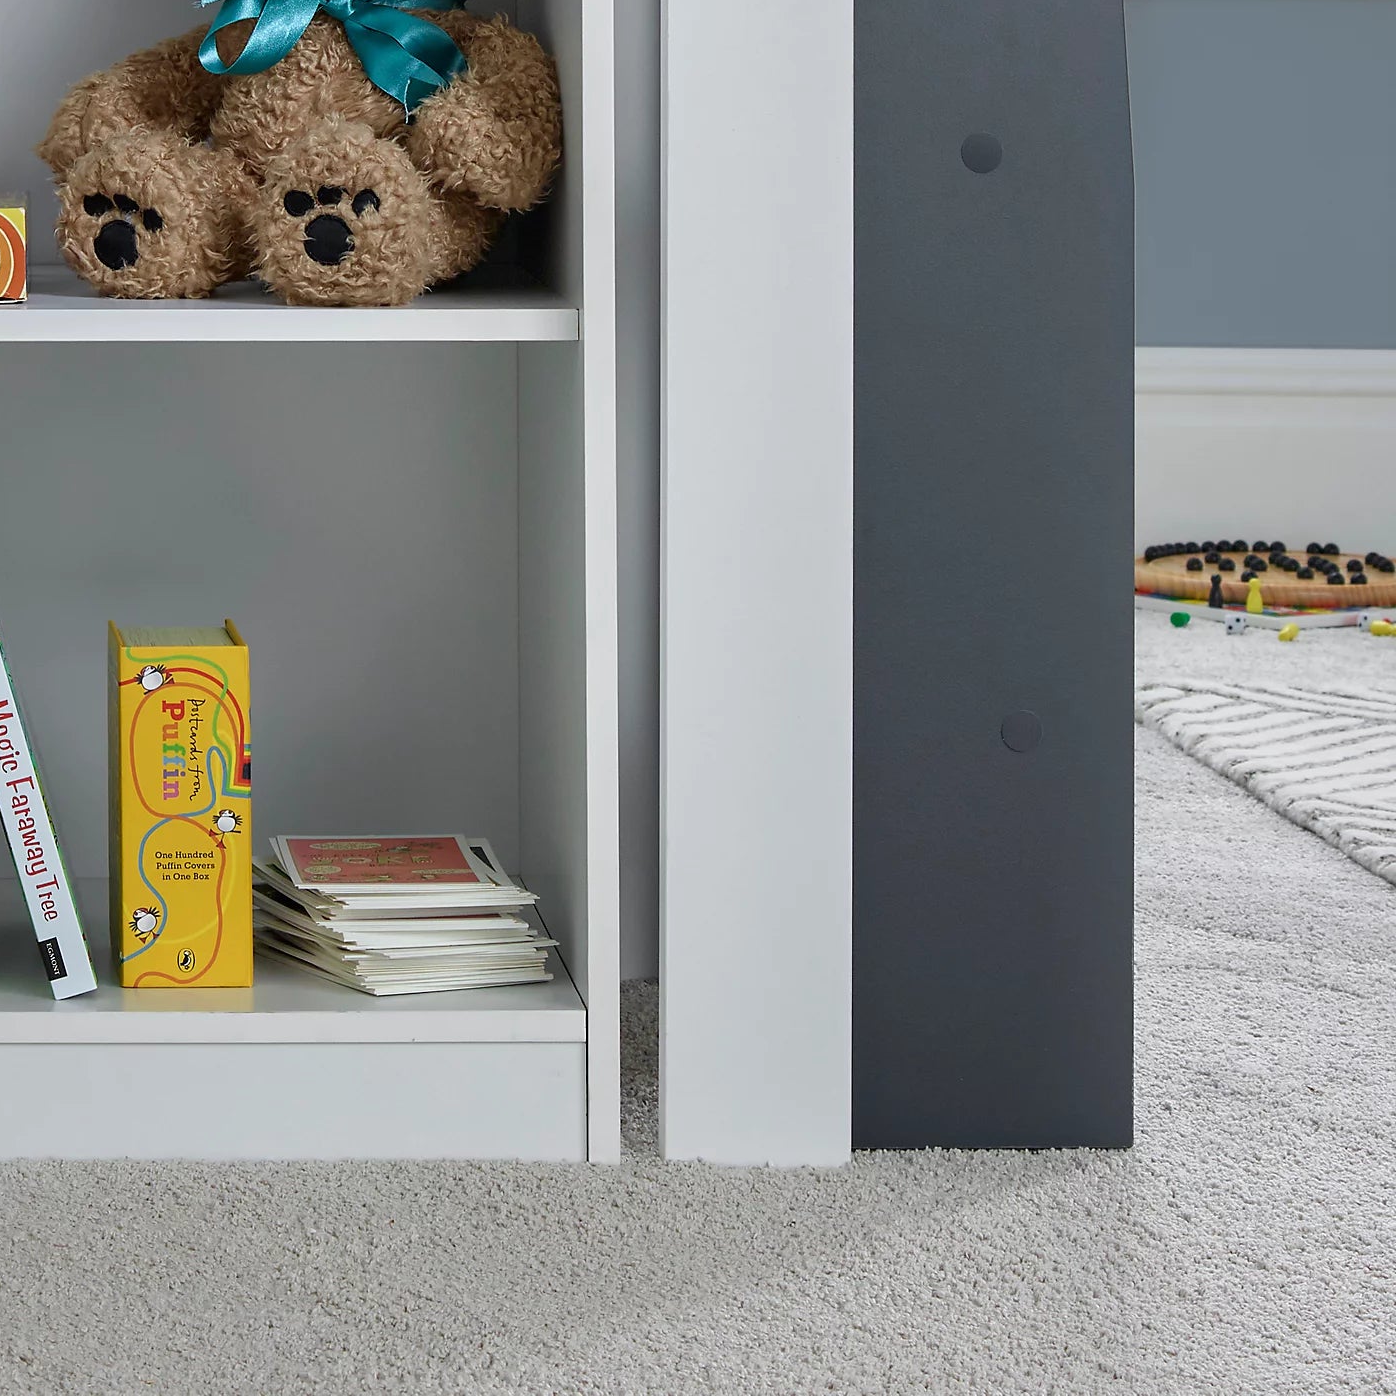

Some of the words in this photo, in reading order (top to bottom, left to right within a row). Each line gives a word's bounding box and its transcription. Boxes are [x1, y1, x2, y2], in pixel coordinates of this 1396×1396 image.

[161, 700, 186, 801] Puffin
[187, 764, 205, 801] from
[5, 775, 48, 877] Faraway
[35, 874, 60, 923] Tree
[154, 850, 173, 859] One
[175, 850, 214, 859] Hundred
[156, 861, 182, 870] Puffin
[184, 861, 215, 870] Covers
[162, 872, 171, 881] in
[172, 872, 191, 881] One
[193, 872, 210, 881] Box
[45, 942, 61, 976] EGMONT
